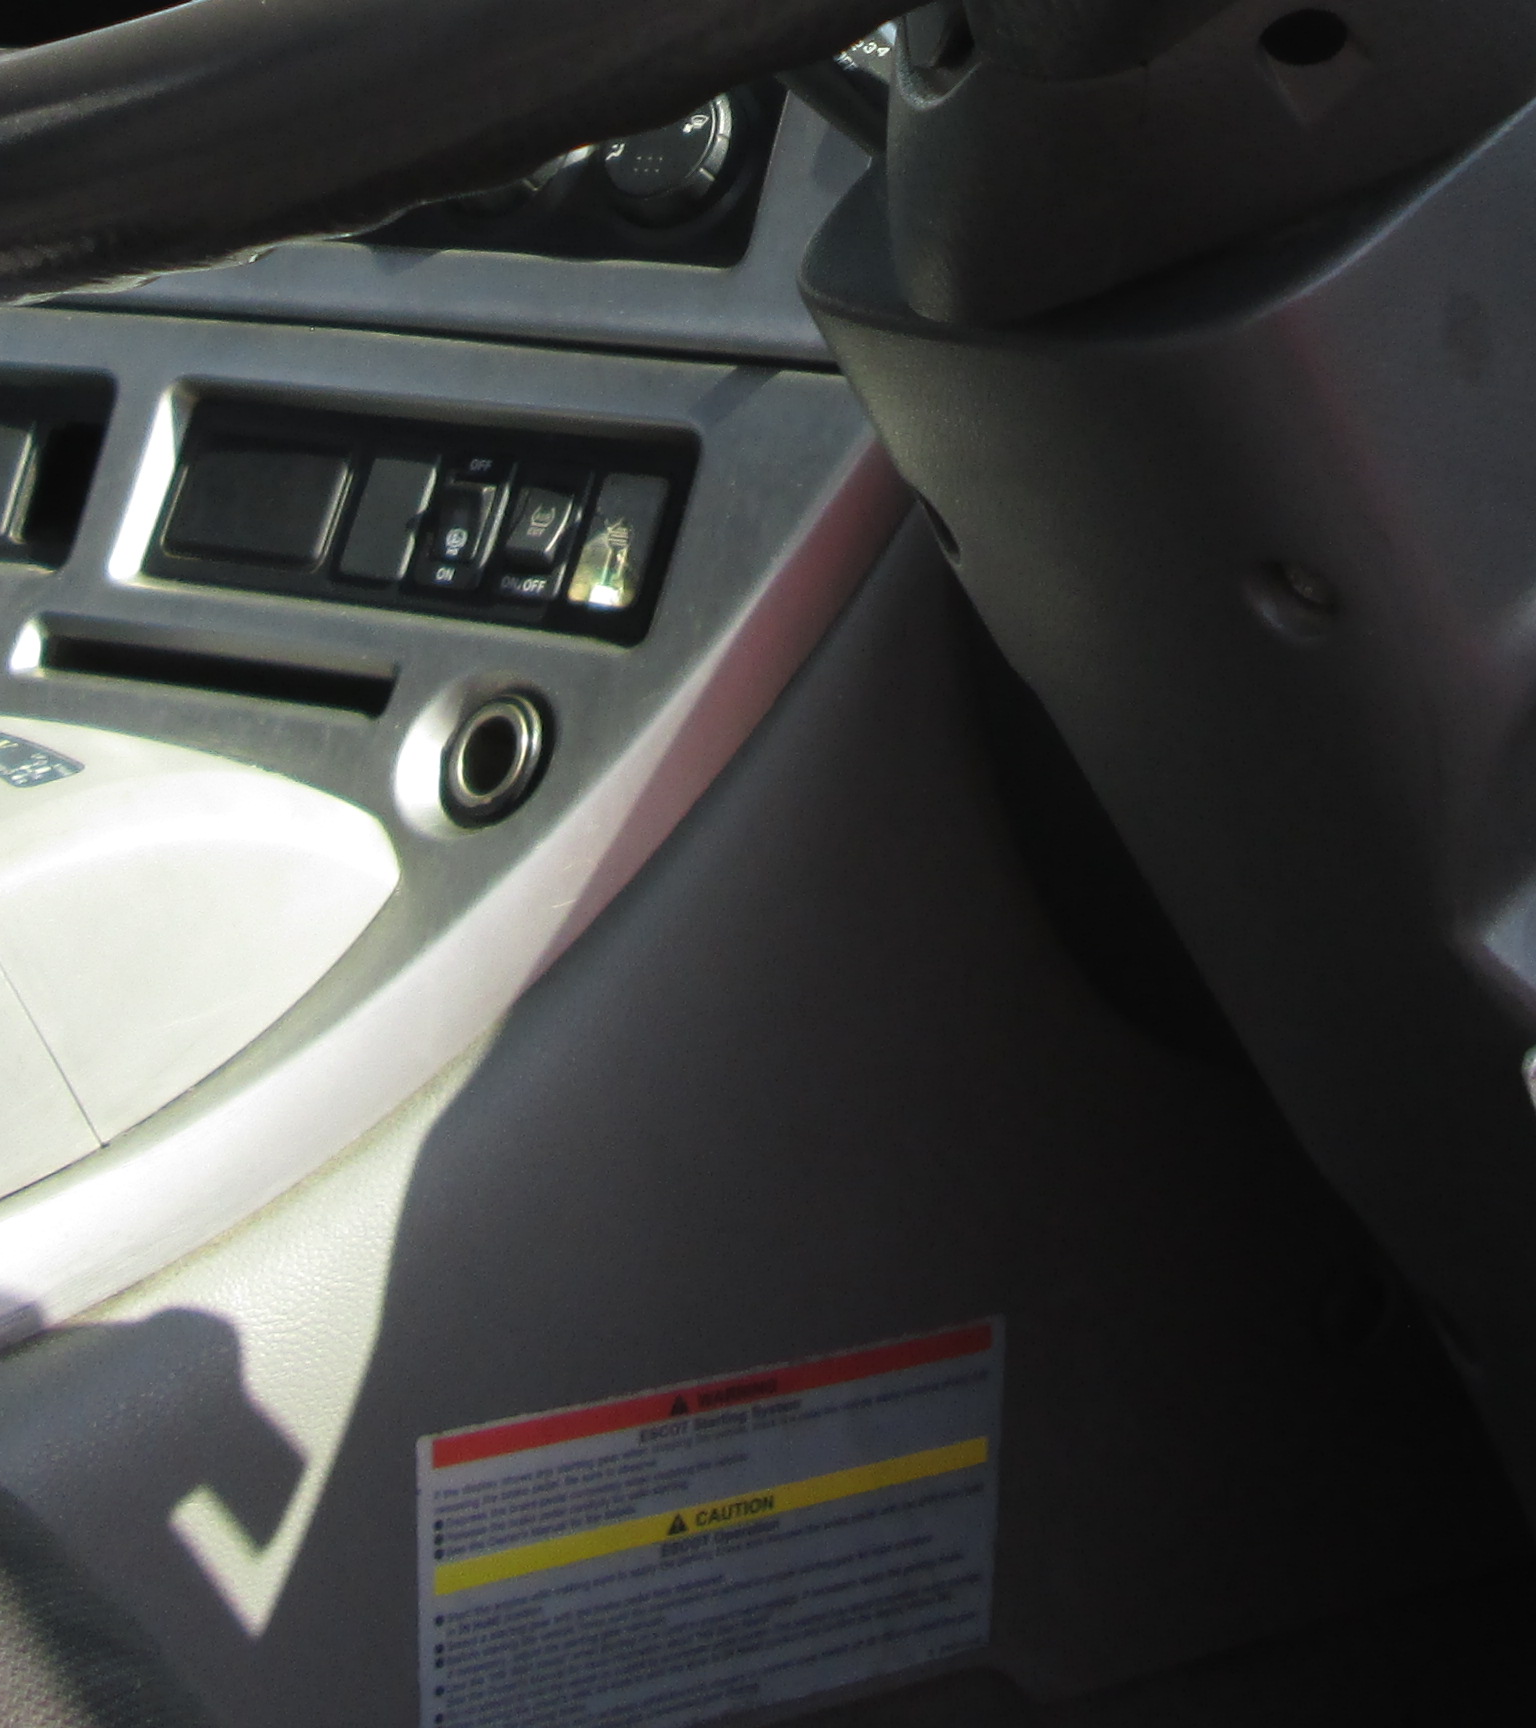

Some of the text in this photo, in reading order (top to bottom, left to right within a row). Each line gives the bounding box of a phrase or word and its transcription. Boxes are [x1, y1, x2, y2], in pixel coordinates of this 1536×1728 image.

[470, 458, 493, 471] OFF
[435, 567, 455, 581] ON
[696, 1494, 775, 1526] CAUTION
